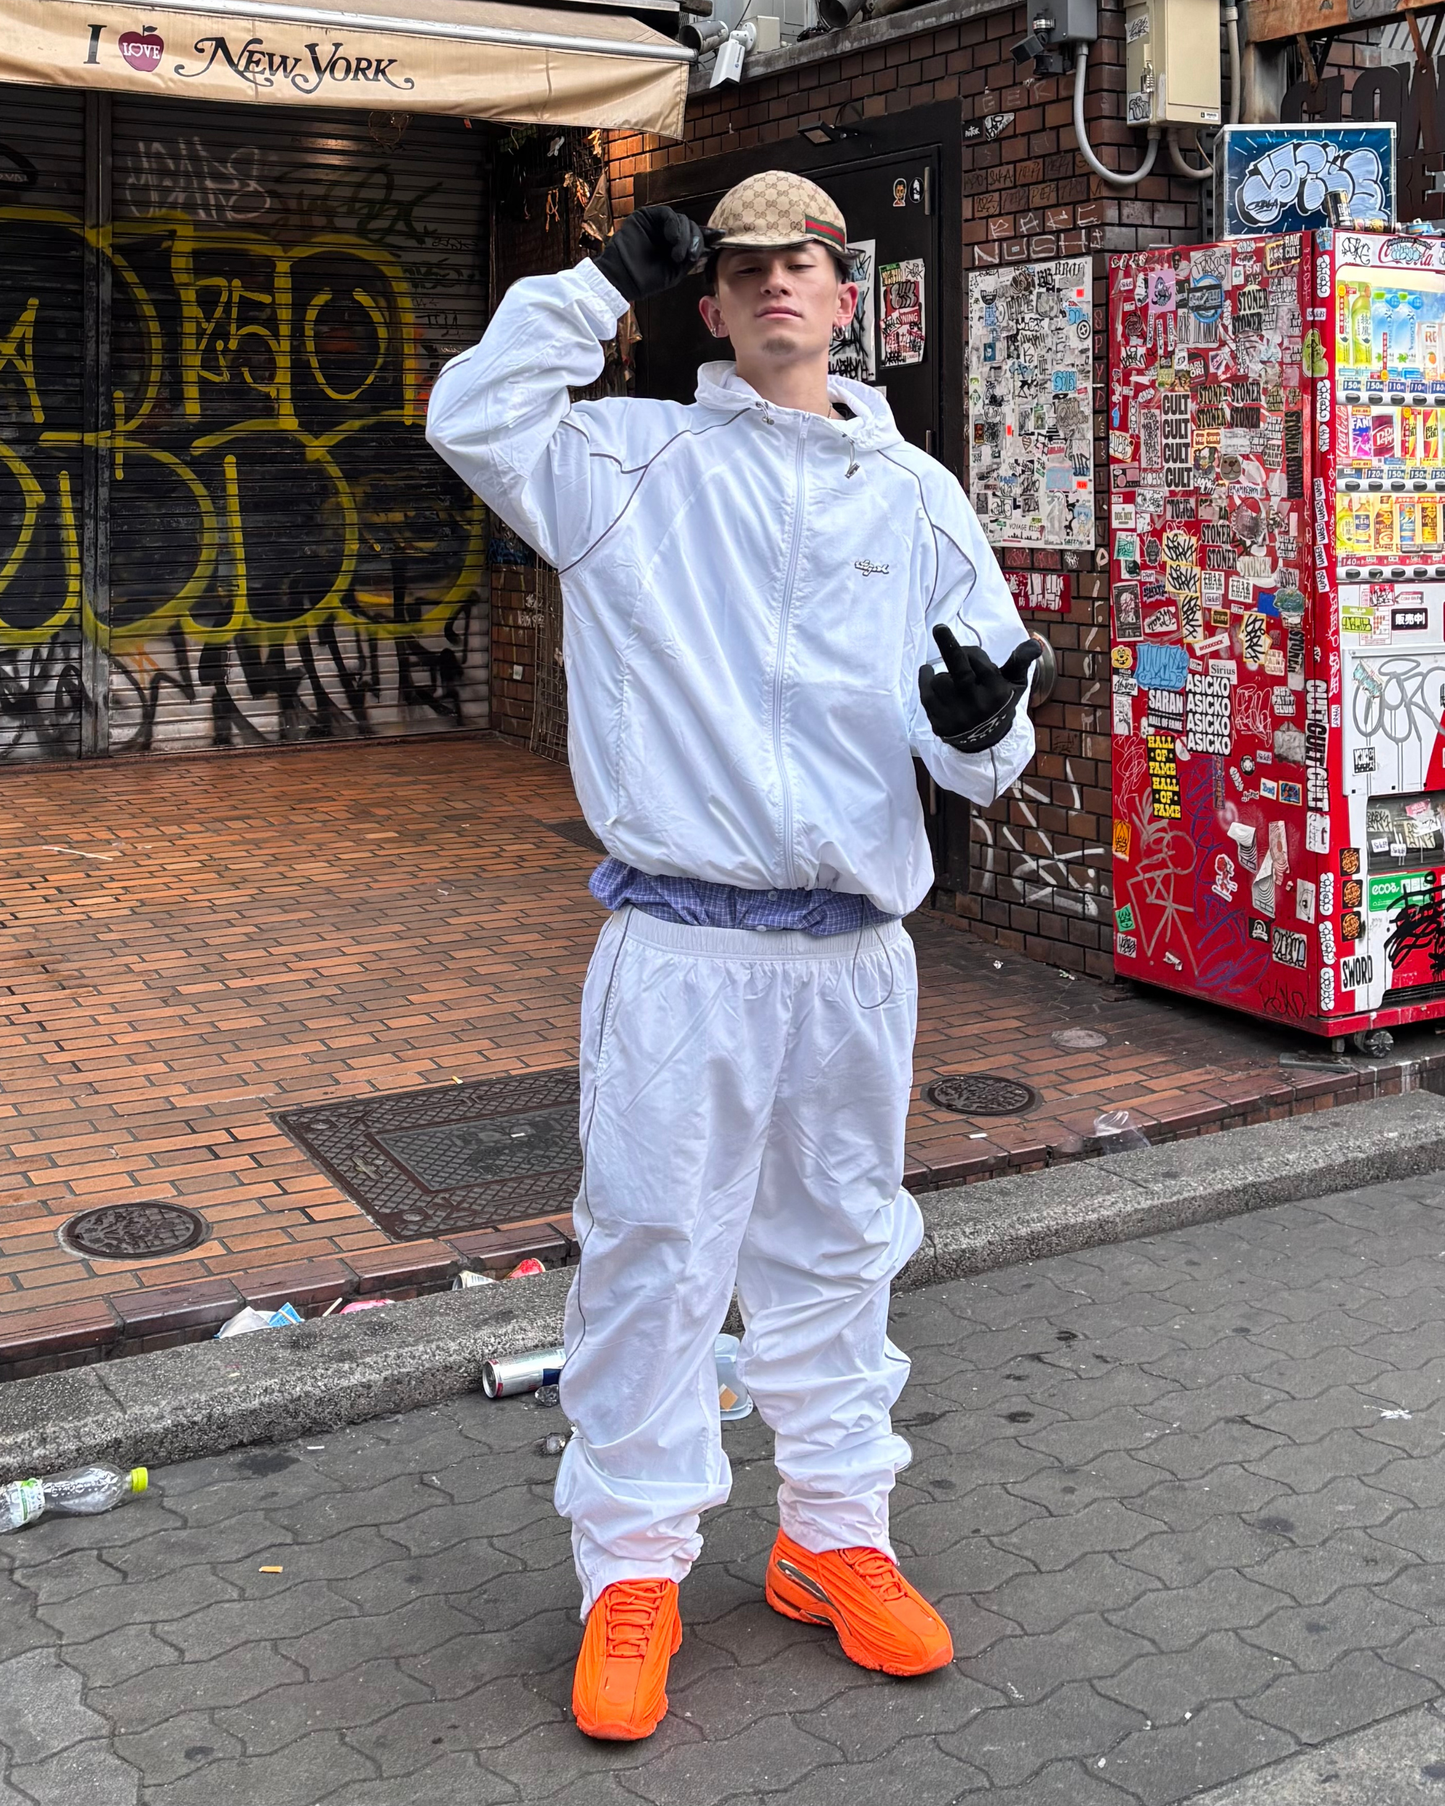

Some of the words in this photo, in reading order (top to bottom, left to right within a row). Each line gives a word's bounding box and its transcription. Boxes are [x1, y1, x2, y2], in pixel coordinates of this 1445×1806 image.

[83, 23, 106, 65] I
[122, 42, 161, 60] LOVE
[1285, 246, 1301, 258] CULT
[1238, 288, 1269, 312] STONER
[1231, 382, 1262, 403] STONER
[1162, 393, 1190, 415] CULT
[1162, 418, 1190, 440] CULT
[1197, 408, 1227, 428] STONER
[1230, 407, 1261, 429] STONER
[1164, 443, 1191, 464] CULT
[1165, 467, 1193, 489] CULT
[1202, 524, 1231, 544] STONER
[1207, 548, 1237, 570] STONER
[1240, 556, 1272, 578] STONER
[1210, 663, 1236, 676] Sirius
[1187, 675, 1230, 697] ASICKO
[1148, 689, 1184, 714] SARAN
[1187, 694, 1231, 717] ASICKO
[1306, 680, 1328, 723] CULT
[1149, 714, 1161, 726] HALL
[1161, 716, 1169, 728] OF
[1168, 718, 1183, 731] FAME
[1187, 714, 1231, 736] ASICKO
[1147, 736, 1174, 748] HALL
[1187, 734, 1231, 756] ASICKO
[1305, 723, 1328, 768] CULT
[1156, 749, 1167, 760] OF
[1149, 763, 1176, 775] FAME
[1152, 777, 1179, 790] HALL
[1307, 767, 1329, 812] CULT
[1160, 791, 1172, 803] OF
[1153, 804, 1181, 818] FAME
[1342, 954, 1374, 989] SWORD
